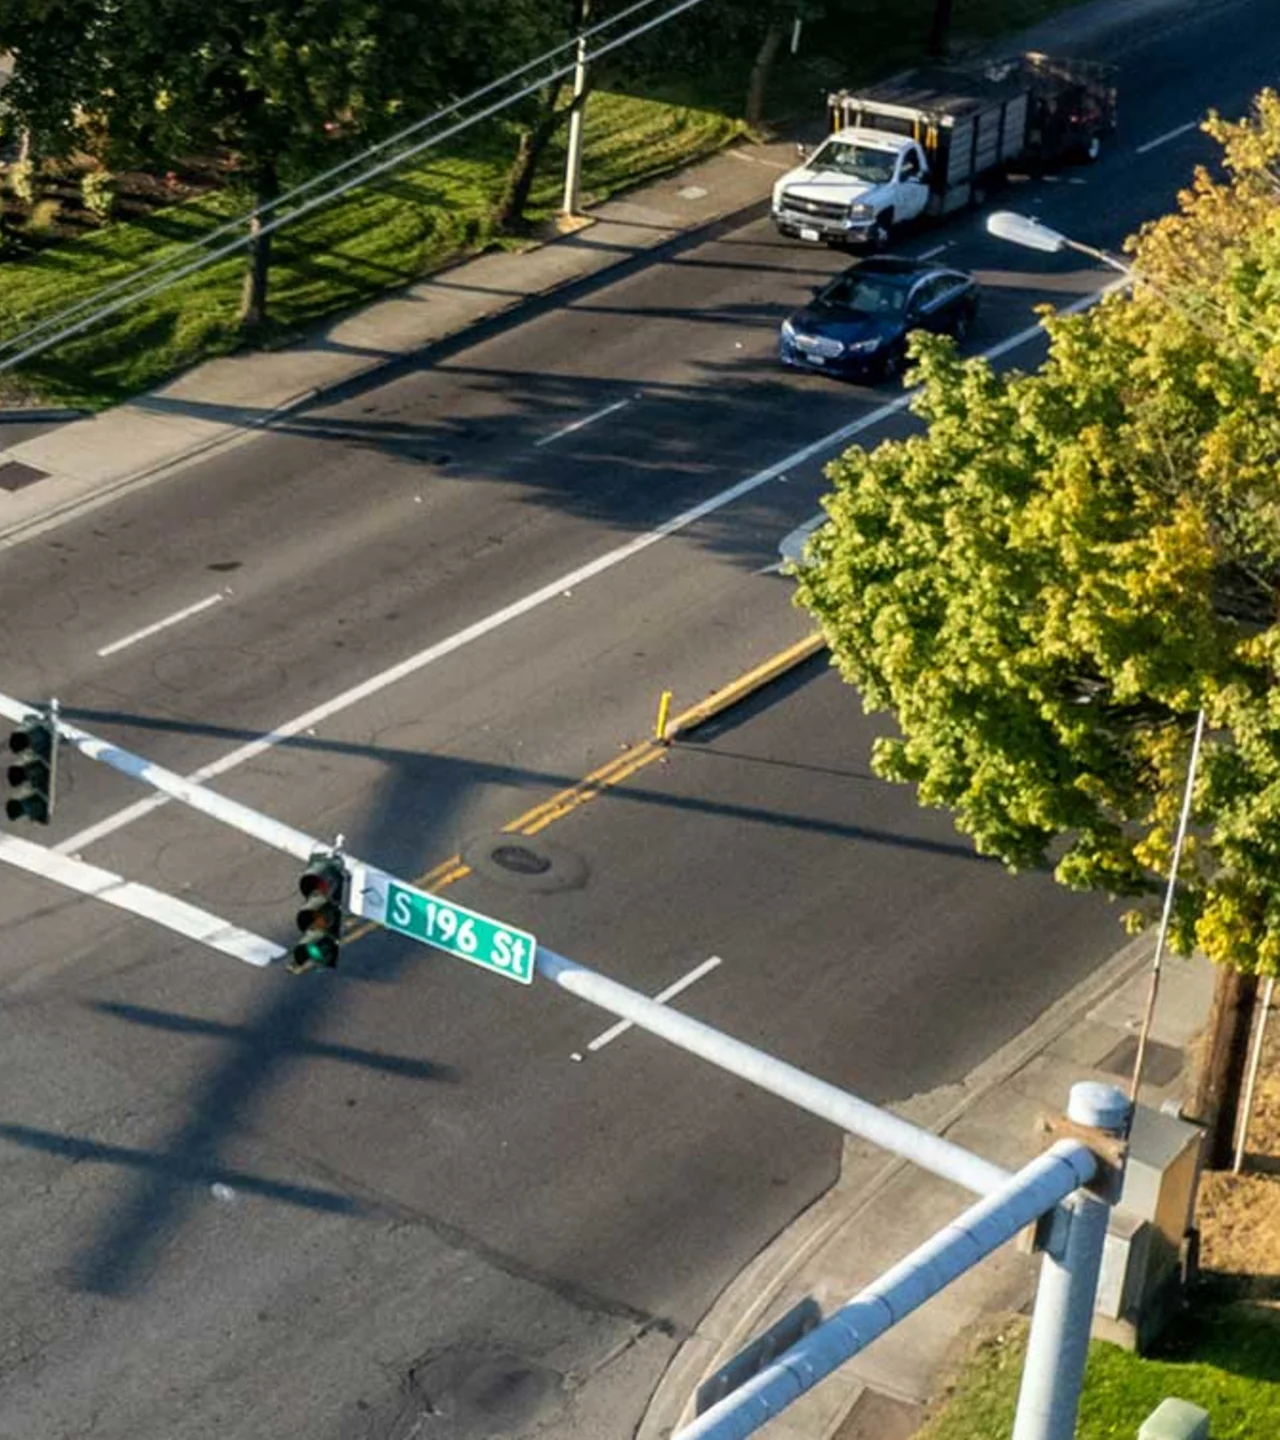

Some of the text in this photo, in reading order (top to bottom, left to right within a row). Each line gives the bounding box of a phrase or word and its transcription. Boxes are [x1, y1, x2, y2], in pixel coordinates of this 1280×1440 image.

[392, 892, 527, 974] S 196 St
